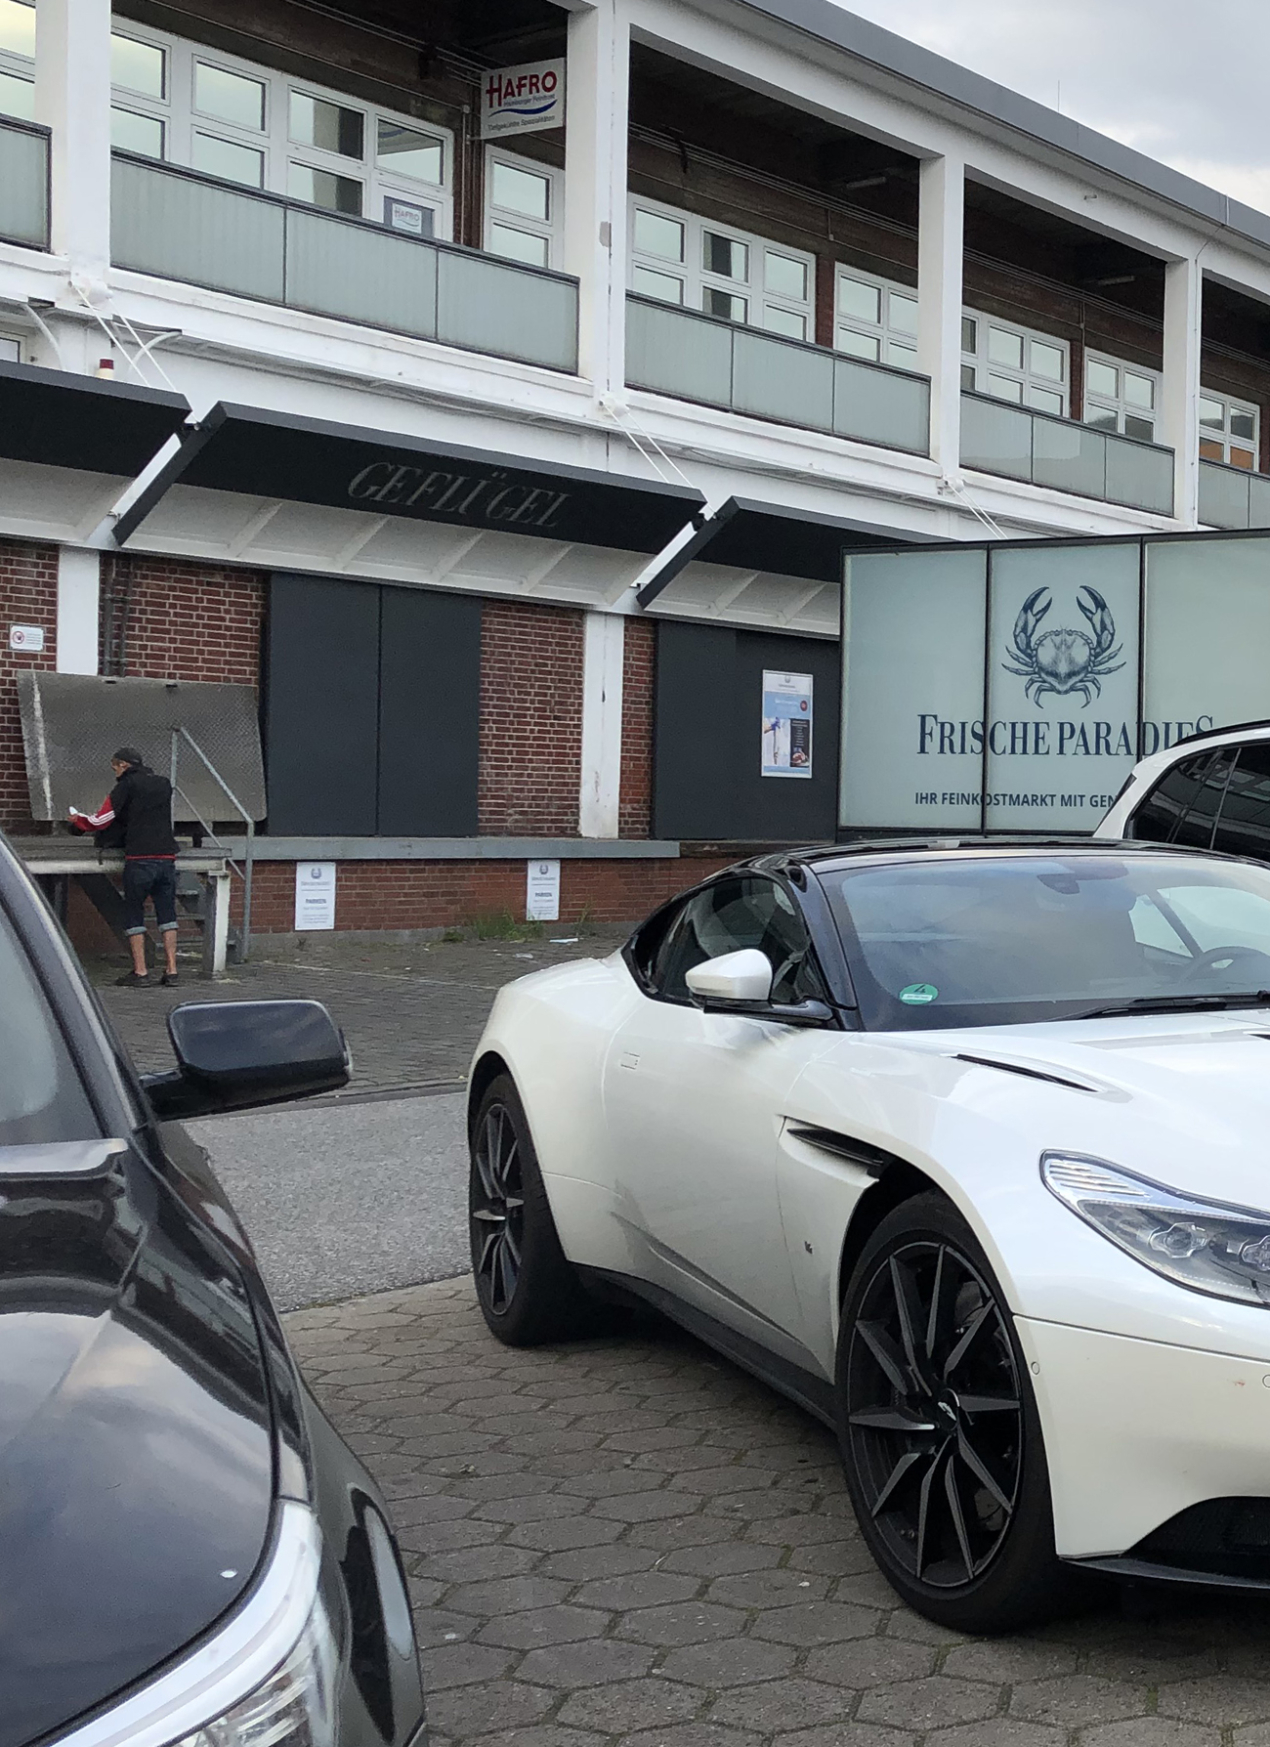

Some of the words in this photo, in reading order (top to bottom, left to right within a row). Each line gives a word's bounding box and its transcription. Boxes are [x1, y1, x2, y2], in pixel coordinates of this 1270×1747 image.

[486, 70, 558, 108] HAFRO
[347, 461, 572, 528] GEFLÜGEL
[915, 792, 938, 805] IHR
[941, 792, 1057, 807] FEINKOSTMARKT
[1060, 794, 1086, 807] MIT
